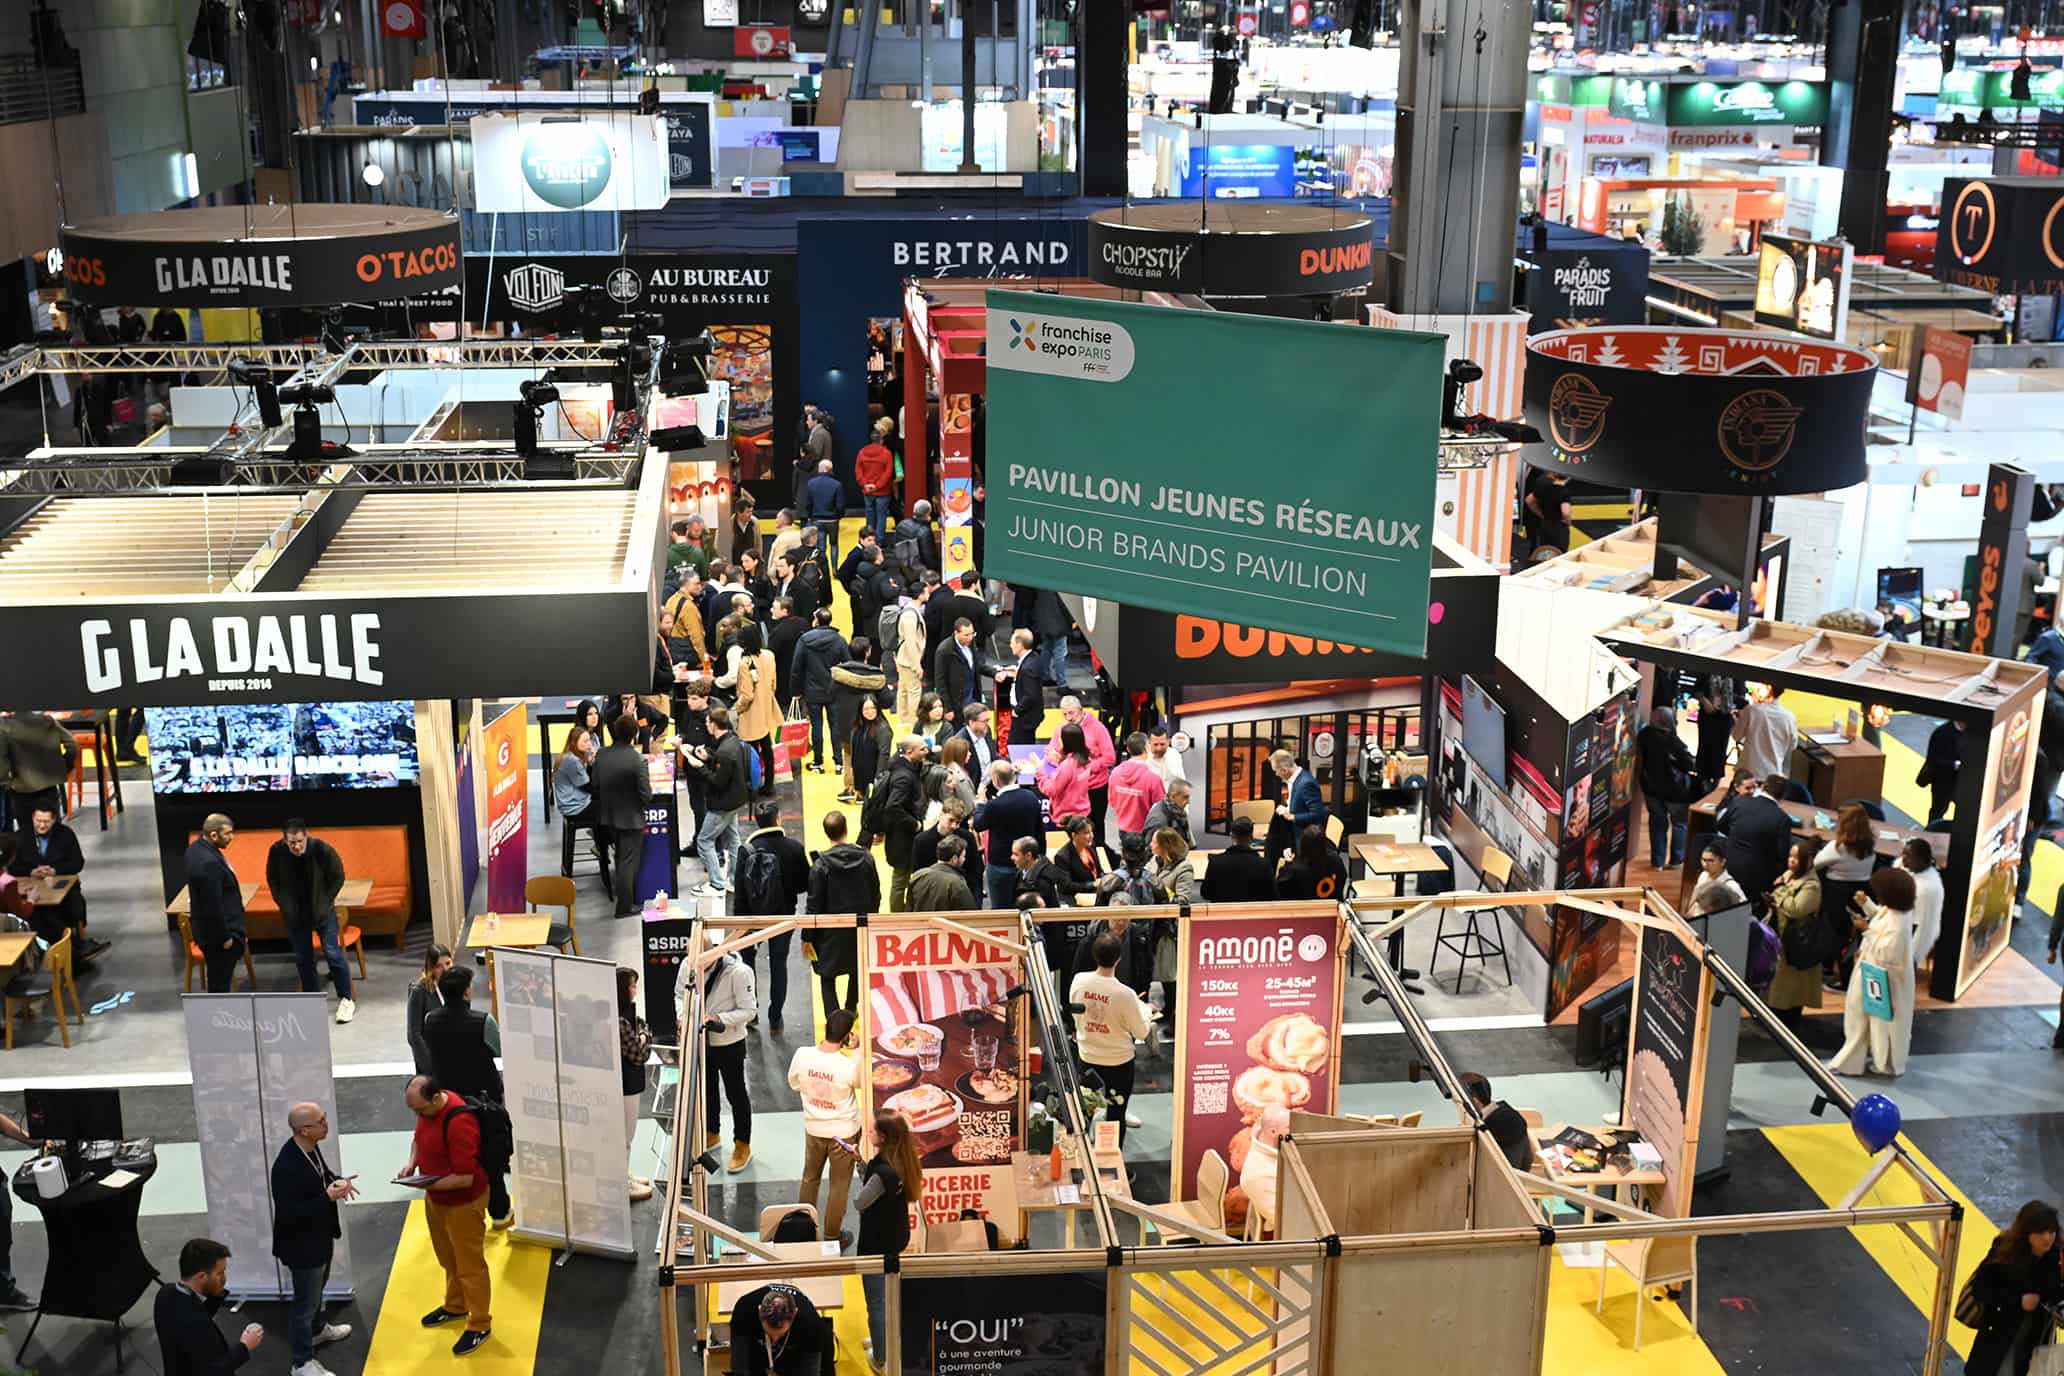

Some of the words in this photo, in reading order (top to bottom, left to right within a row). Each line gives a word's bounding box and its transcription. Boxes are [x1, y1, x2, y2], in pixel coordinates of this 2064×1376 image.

[1671, 130, 1739, 148] franprix
[356, 242, 457, 282] O'TACOS
[894, 241, 1069, 265] BERTRAND
[156, 257, 172, 293] G
[176, 257, 210, 288] LA
[211, 254, 293, 292] DALLE
[649, 270, 680, 287] AU
[684, 268, 770, 287] BUREAU
[1554, 268, 1611, 289] PARADIS
[1569, 285, 1611, 306] FRUIT
[1042, 322, 1112, 344] franchise
[1008, 463, 1141, 507] PAVILLON
[1150, 486, 1265, 527] JEUNES
[1276, 498, 1420, 550] RÉSEAUX
[1008, 514, 1104, 553] JUNIOR
[1113, 532, 1226, 574] BRANDS
[1236, 552, 1367, 597] PAVILION
[1175, 613, 1375, 660] DUN
[80, 619, 122, 694] G
[130, 617, 204, 684] LA
[212, 613, 384, 686] DALLE
[208, 680, 246, 692] DEPUIS
[246, 678, 272, 690] 2014
[876, 930, 1012, 967] BALME
[1208, 1028, 1231, 1040] 7%
[920, 1174, 991, 1192] PICERIE
[924, 1193, 983, 1211] RUFFE
[950, 1350, 970, 1358] une
[974, 1348, 1022, 1358] aventure
[939, 1361, 1002, 1374] gourmande
